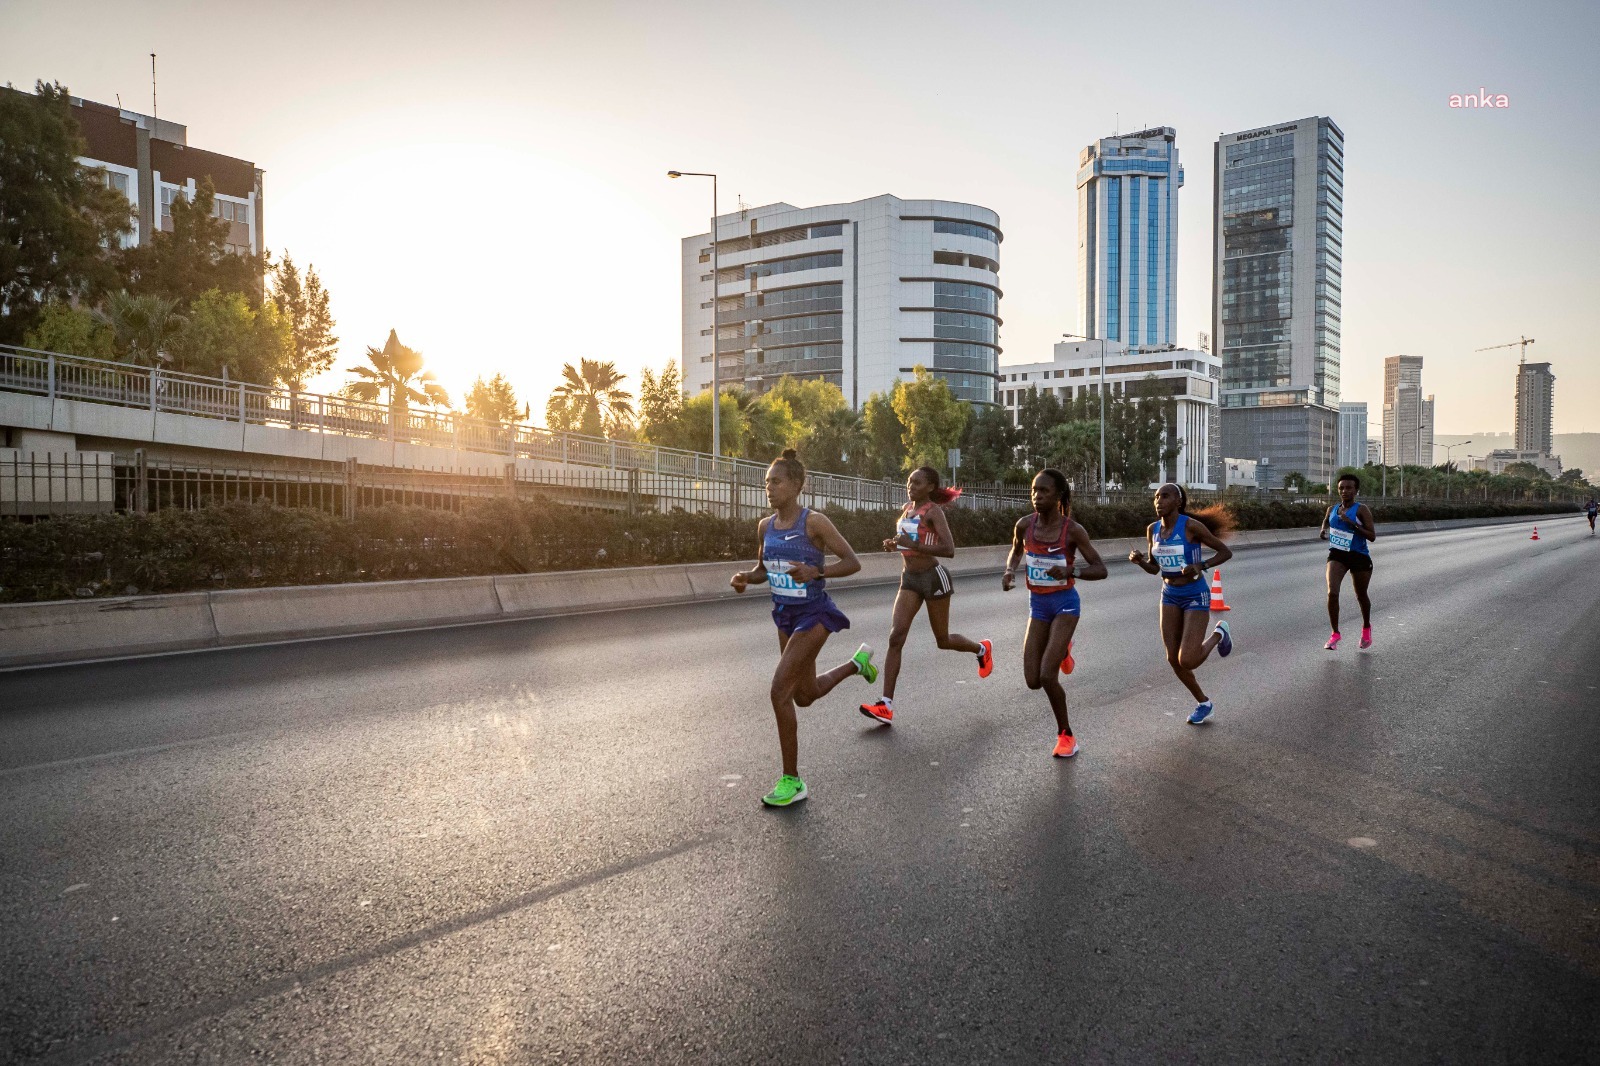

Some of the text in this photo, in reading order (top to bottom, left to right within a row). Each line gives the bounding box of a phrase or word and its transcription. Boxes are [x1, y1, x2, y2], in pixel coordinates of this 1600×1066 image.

[1236, 125, 1298, 141] MEGAPOL TOWER
[1156, 555, 1185, 567] 0015
[767, 573, 805, 589] 1001
